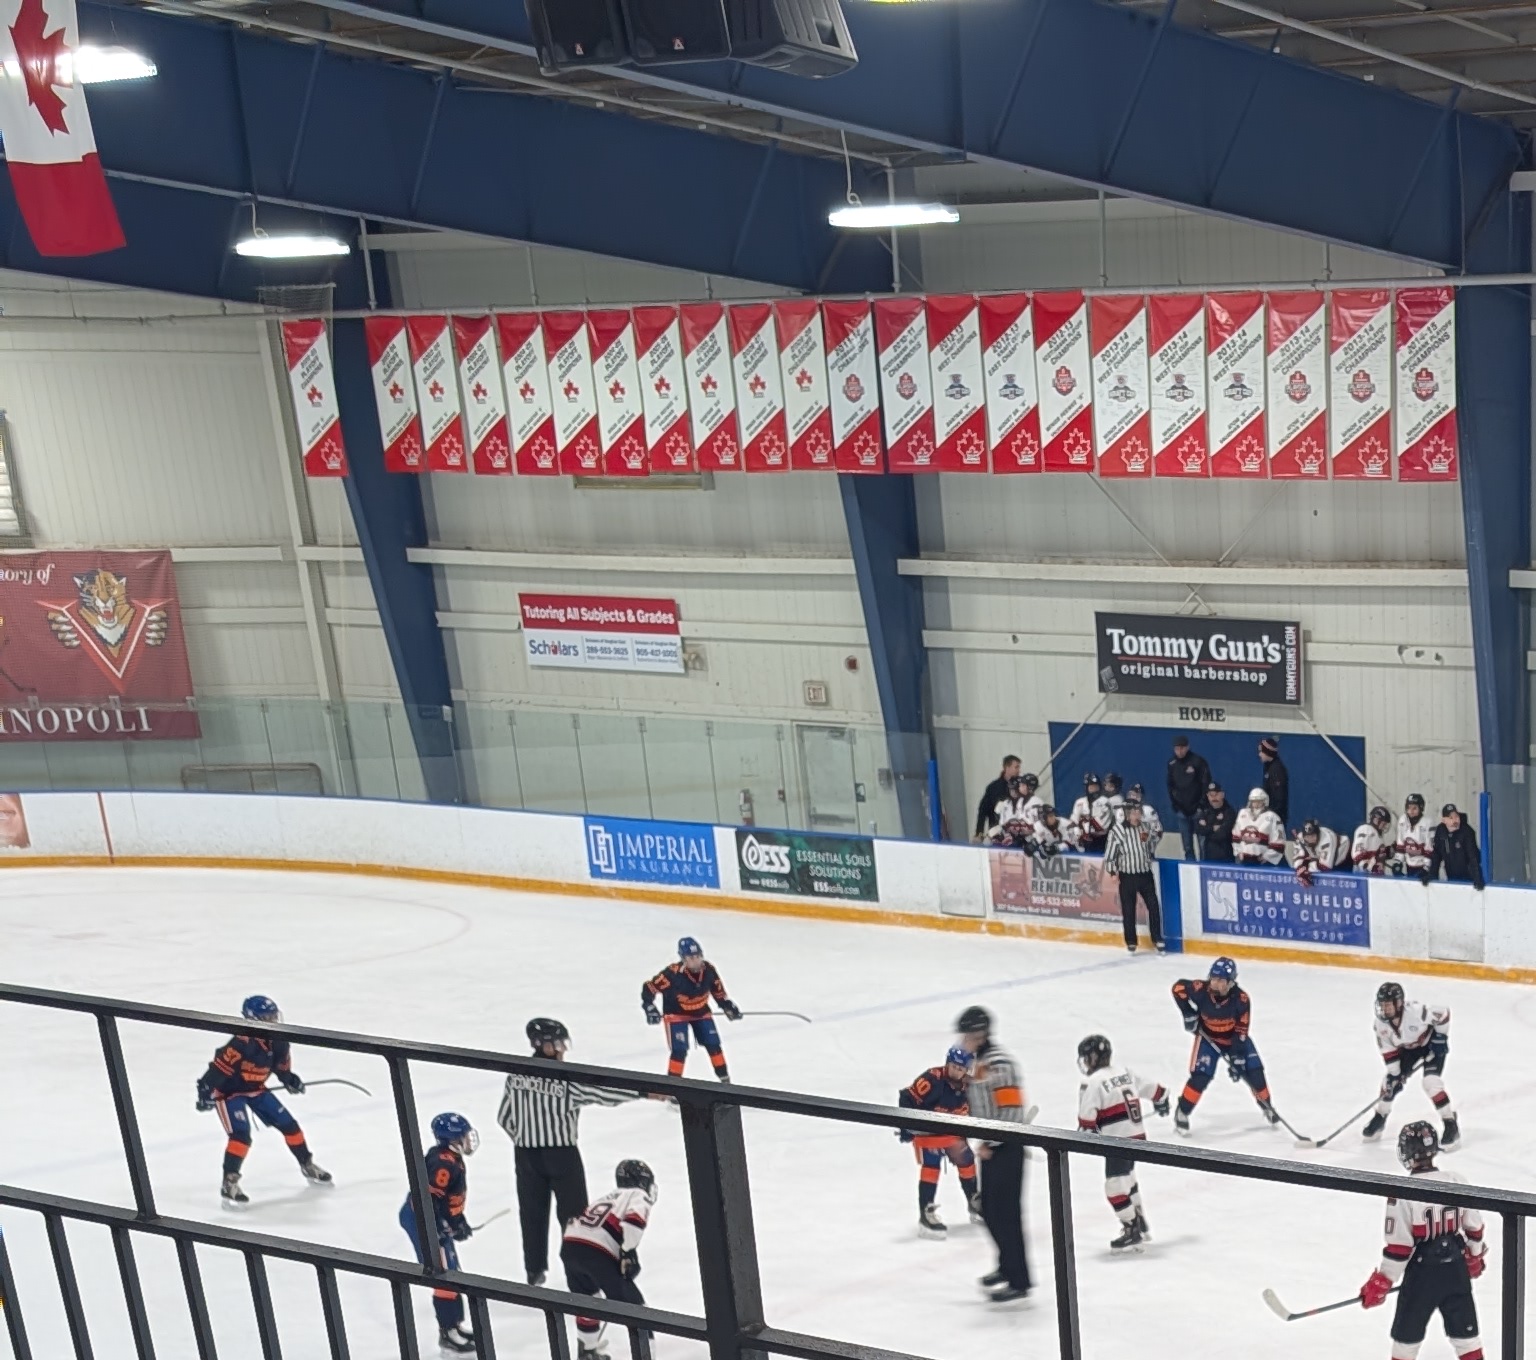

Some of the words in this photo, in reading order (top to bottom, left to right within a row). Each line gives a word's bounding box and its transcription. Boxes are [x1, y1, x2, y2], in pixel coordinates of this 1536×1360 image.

[36, 563, 55, 585] of
[523, 605, 565, 622] Tutoring
[567, 606, 579, 620] All
[581, 607, 625, 624] Subjects
[627, 609, 635, 622] &
[636, 609, 675, 625] Grades
[1106, 628, 1203, 665] Tommy
[1209, 634, 1282, 664] Gun's
[1121, 663, 1179, 678] original
[1184, 666, 1268, 686] barbershop
[1178, 706, 1226, 722] HOME
[617, 832, 712, 864] IMPERIAL
[796, 850, 842, 865] ESSENTIAL
[619, 859, 713, 877] INSURANCE
[809, 865, 861, 880] SOLUTIONS
[1032, 856, 1081, 880] NAF
[1031, 879, 1081, 896] RENTALS
[1242, 889, 1284, 903] GLEN
[1293, 893, 1363, 910] SHIELDS
[1243, 905, 1289, 920] FOOT
[1300, 909, 1363, 926] CLINIC
[435, 1167, 450, 1188] 8
